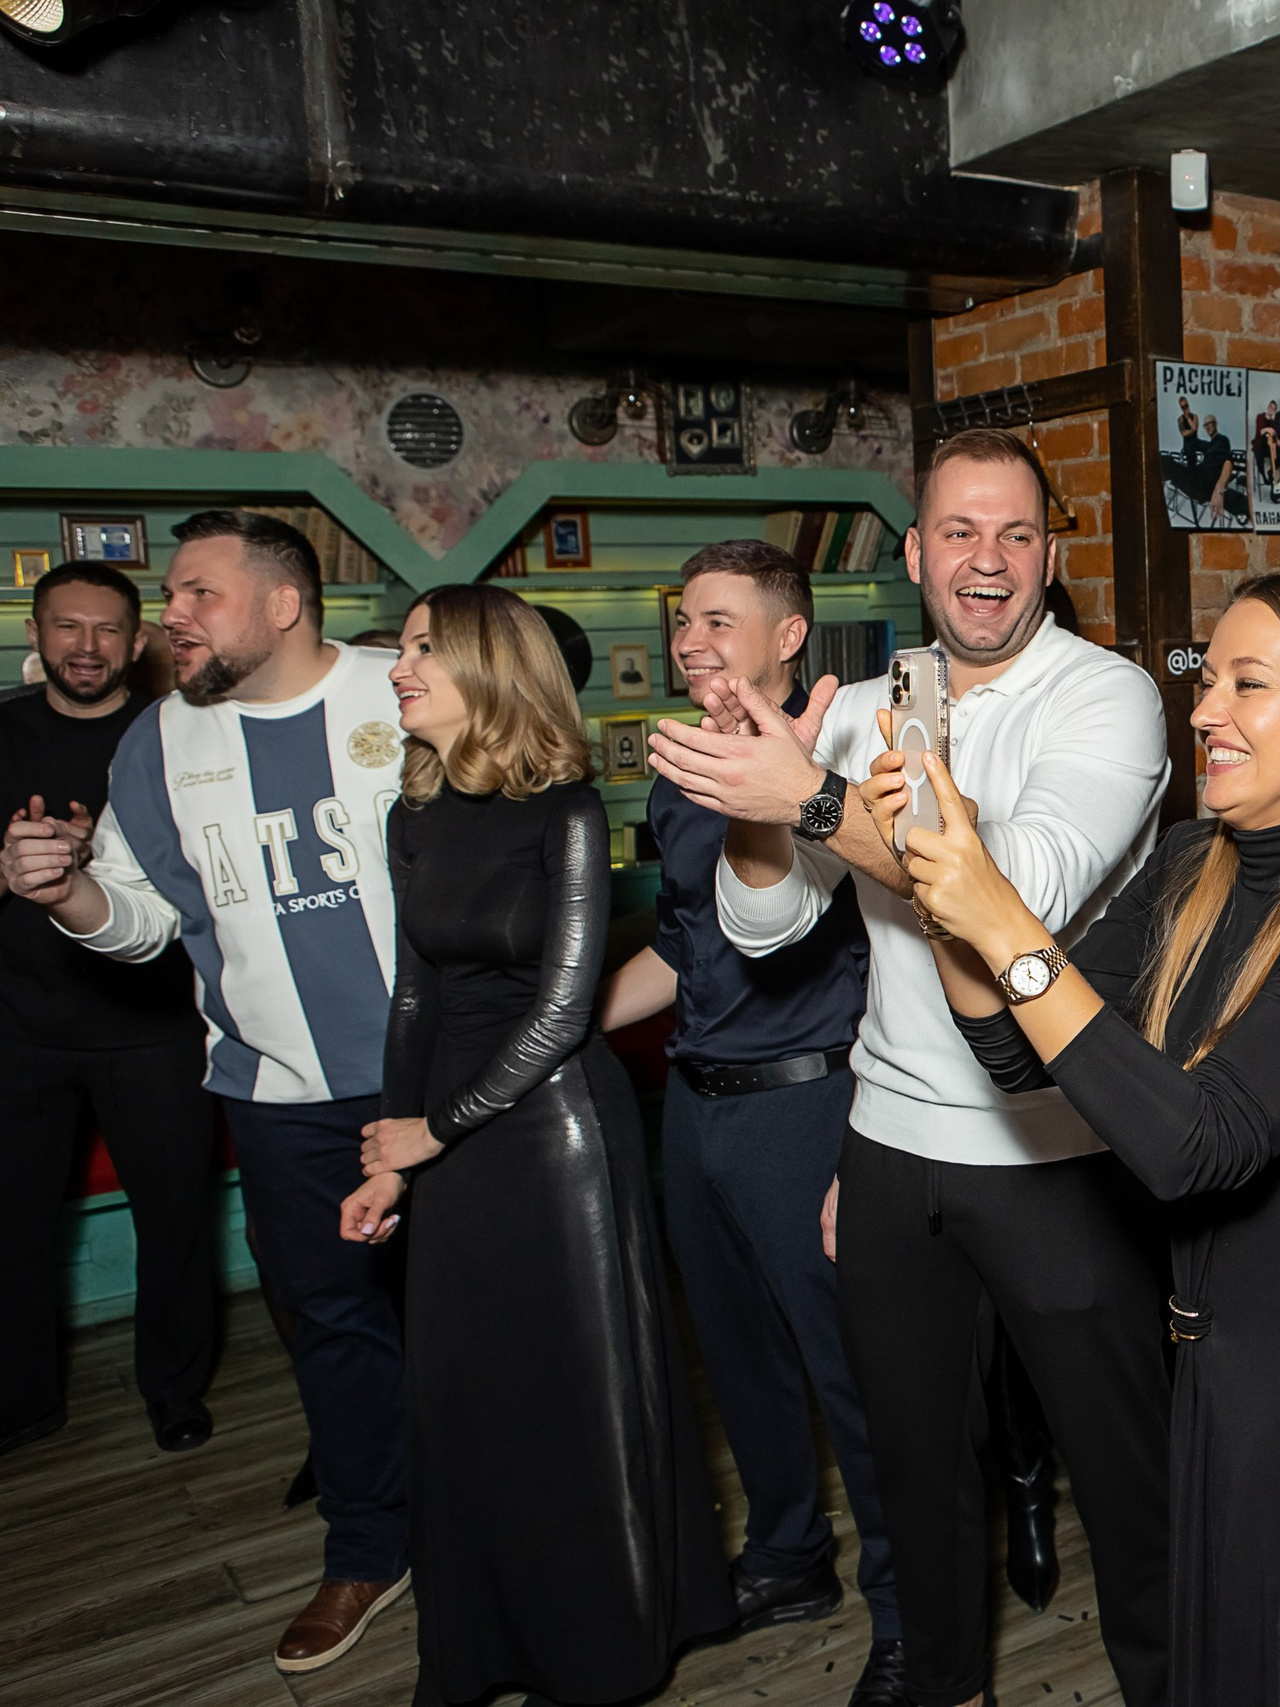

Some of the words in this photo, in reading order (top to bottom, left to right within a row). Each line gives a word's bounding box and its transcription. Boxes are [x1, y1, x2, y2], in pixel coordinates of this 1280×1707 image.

[1163, 365, 1242, 397] PACHULI
[1167, 646, 1207, 676] @b
[288, 888, 348, 913] SPORTS
